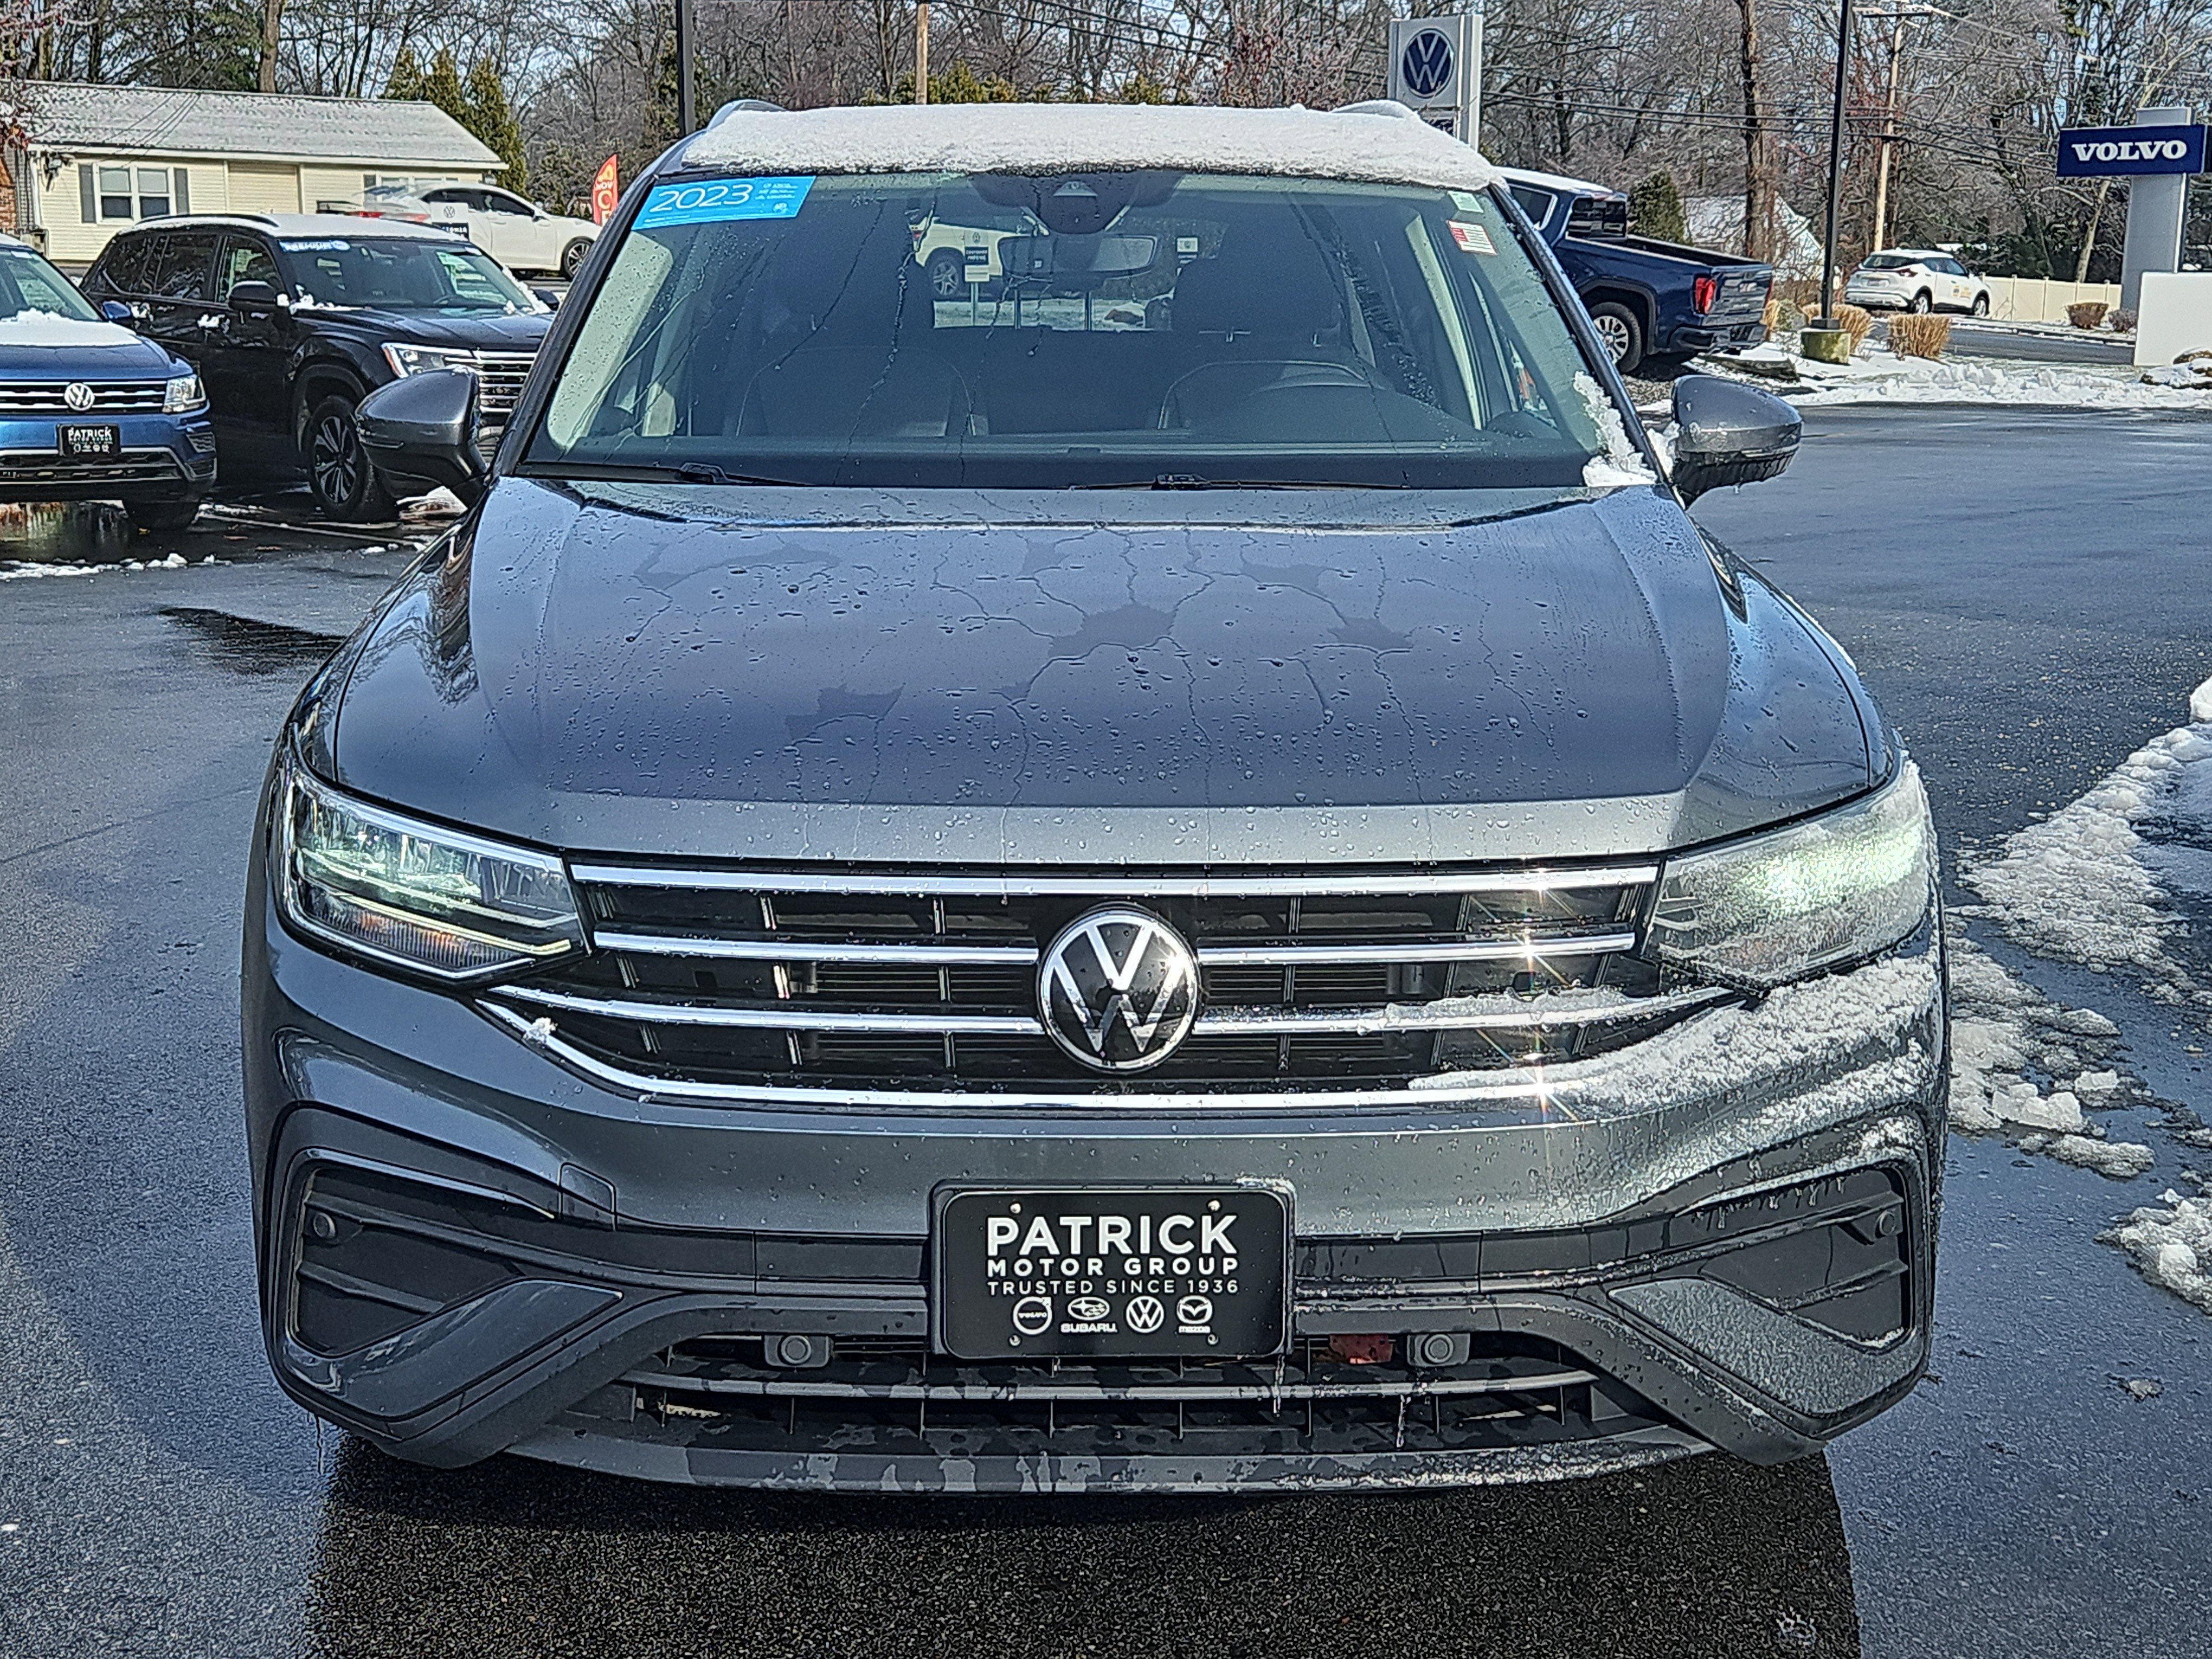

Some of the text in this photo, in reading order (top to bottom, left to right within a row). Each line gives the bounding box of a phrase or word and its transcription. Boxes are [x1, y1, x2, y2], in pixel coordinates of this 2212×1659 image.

[2071, 139, 2187, 161] VOLVO
[649, 184, 753, 212] 2023
[68, 429, 112, 438] PATRICK
[987, 1214, 1237, 1256] PATRICK
[988, 1257, 1238, 1277] MOTOR GROUP
[987, 1279, 1238, 1295] TRUSTED SINCE 1936
[1060, 1323, 1116, 1333] SUBARU
